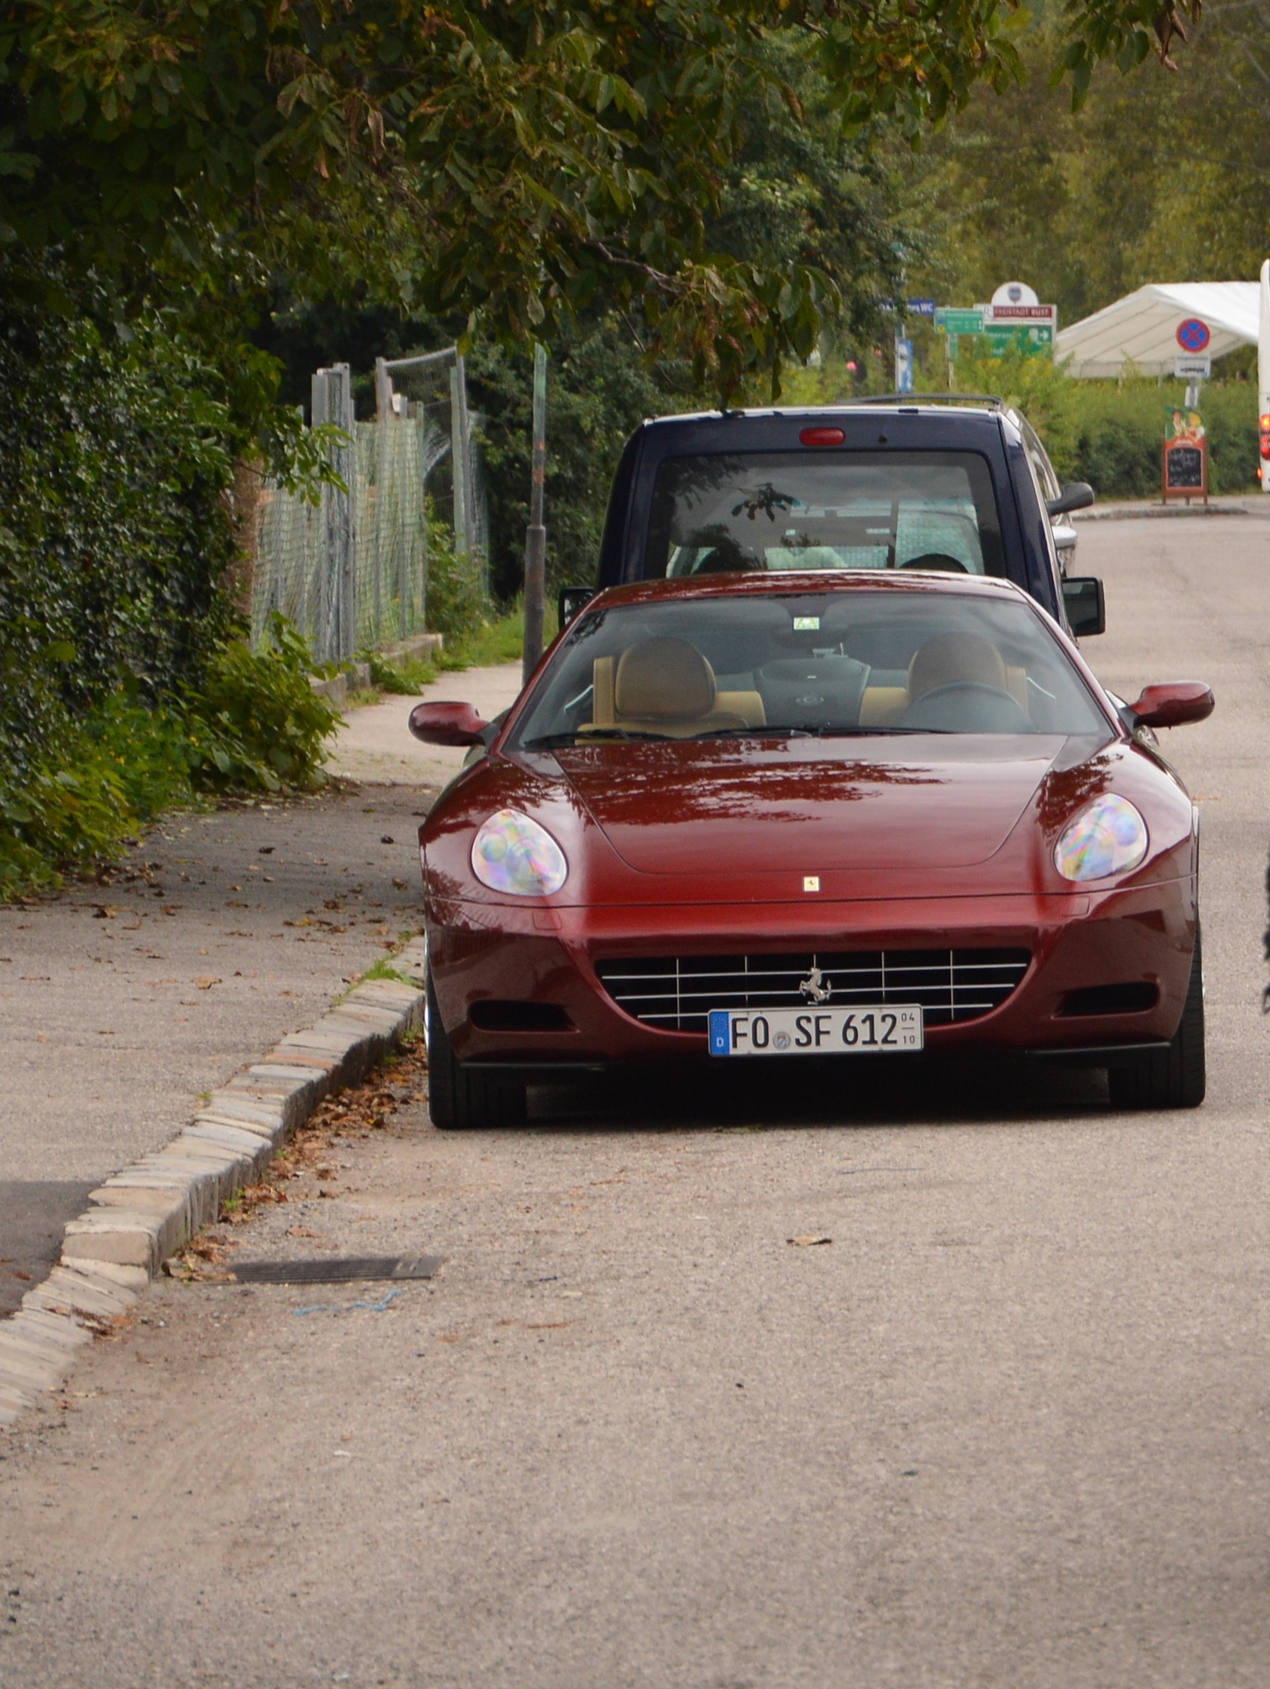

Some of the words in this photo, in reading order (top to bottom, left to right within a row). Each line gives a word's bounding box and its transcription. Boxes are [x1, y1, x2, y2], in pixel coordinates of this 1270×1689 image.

[716, 1037, 724, 1047] D
[731, 1016, 770, 1049] FO
[795, 1015, 832, 1047] SF
[842, 1013, 898, 1045] 612
